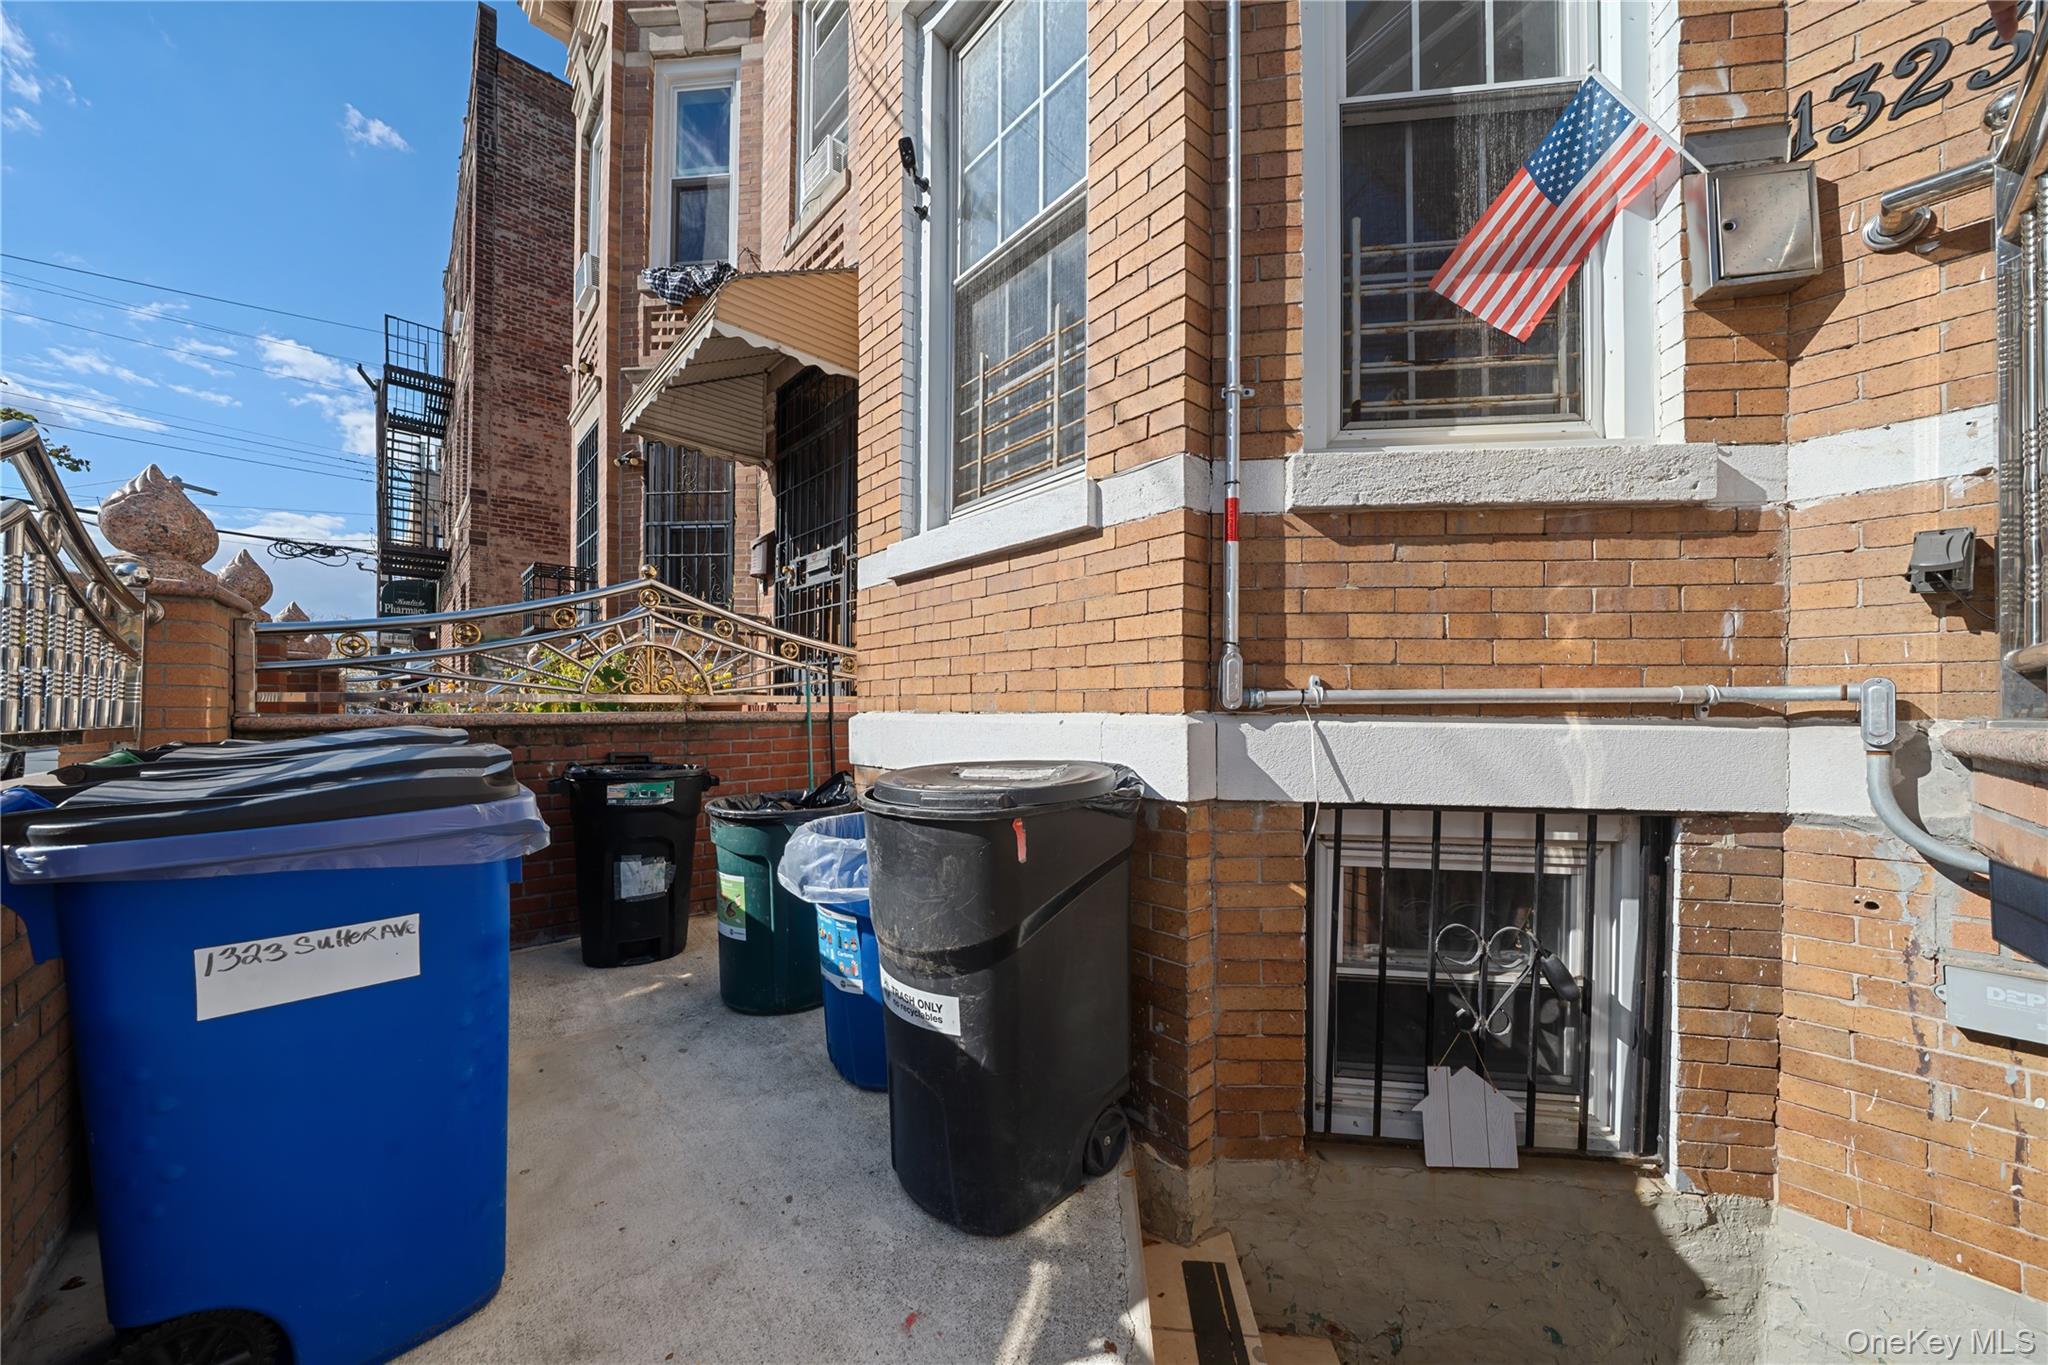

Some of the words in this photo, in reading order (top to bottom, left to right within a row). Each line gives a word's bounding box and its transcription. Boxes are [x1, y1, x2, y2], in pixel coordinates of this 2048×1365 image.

[1790, 0, 2034, 161] 1323
[384, 603, 428, 615] Pharmacy
[204, 942, 288, 977] 1323
[891, 985, 915, 1007] TRASH
[917, 999, 943, 1014] ONLY
[900, 1004, 943, 1024] recyclables
